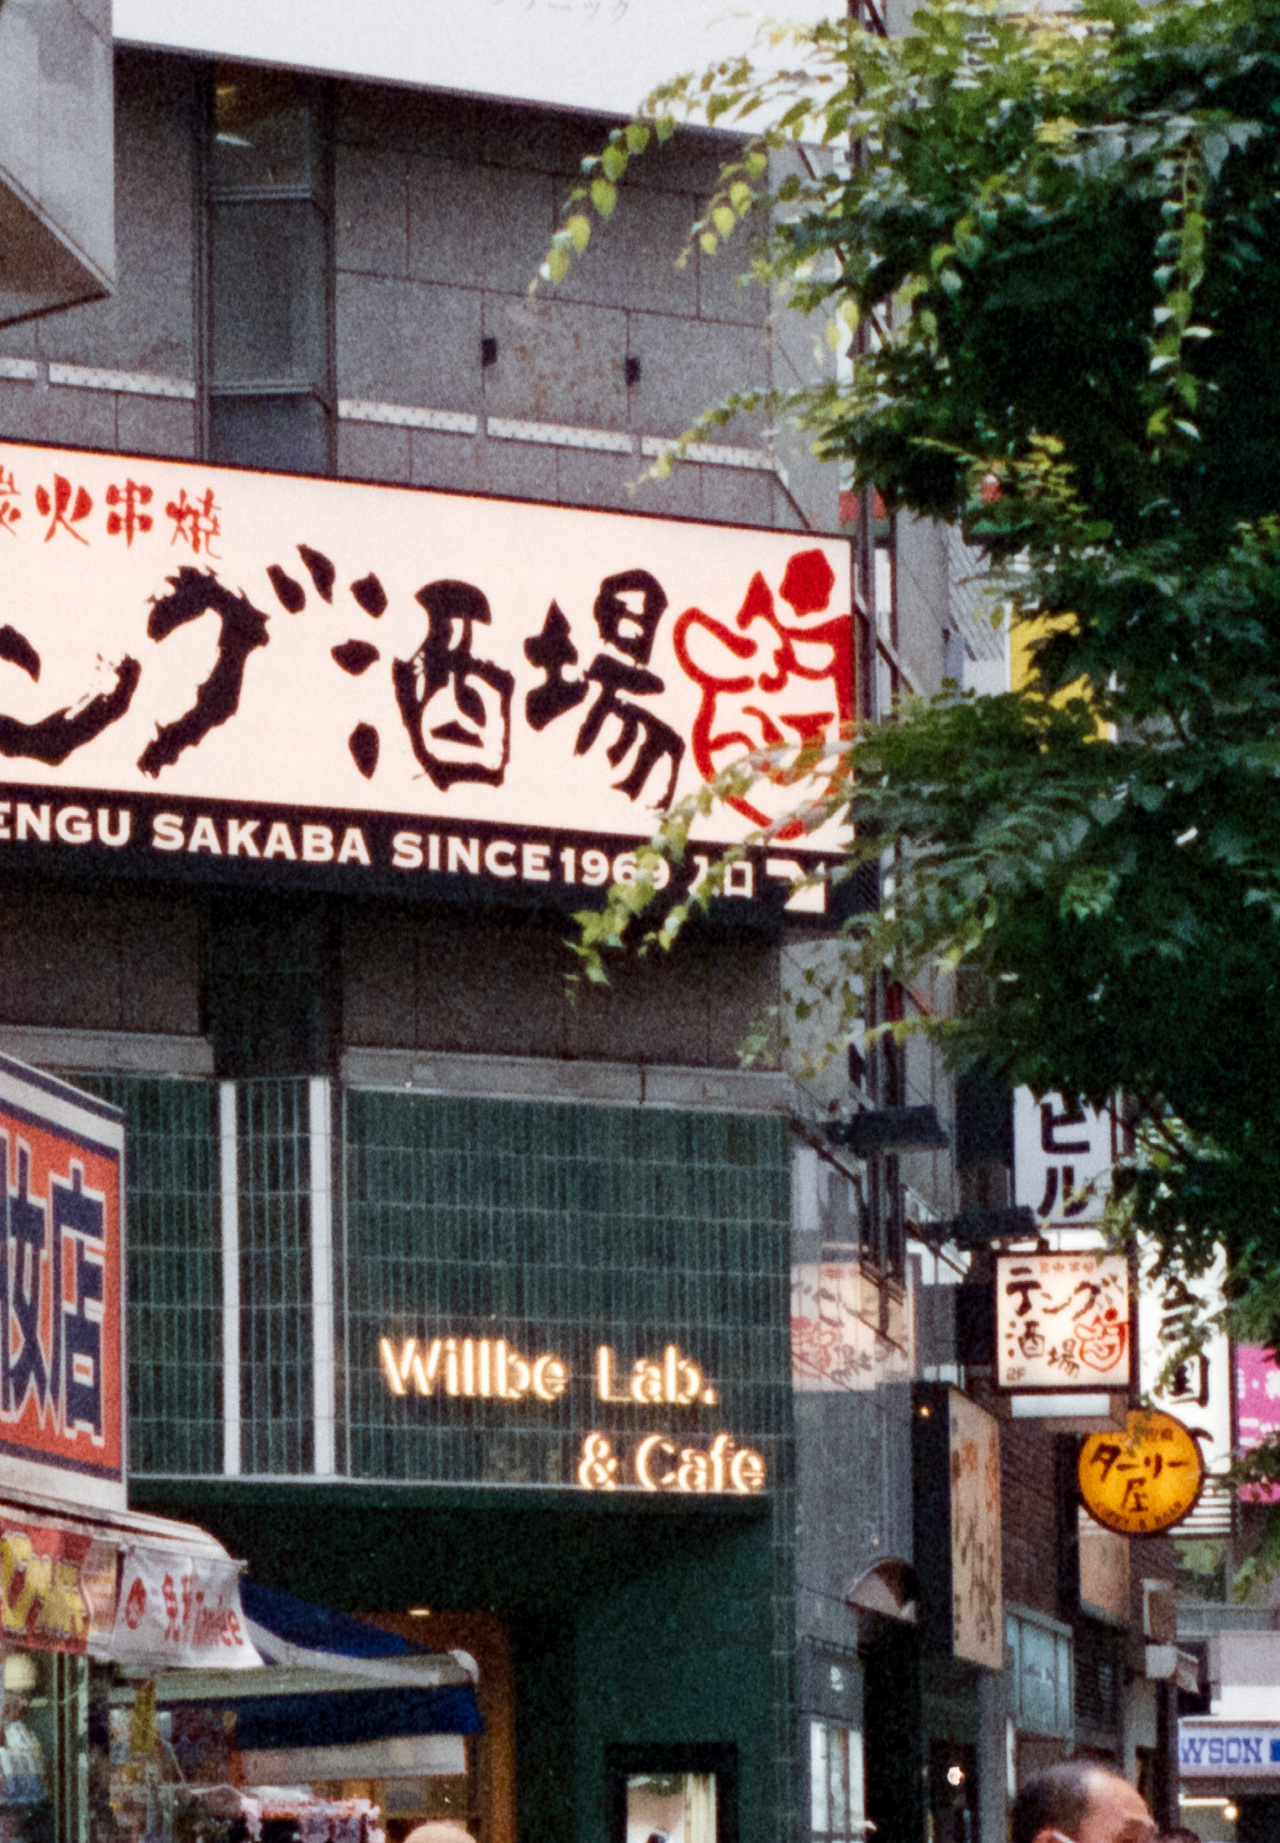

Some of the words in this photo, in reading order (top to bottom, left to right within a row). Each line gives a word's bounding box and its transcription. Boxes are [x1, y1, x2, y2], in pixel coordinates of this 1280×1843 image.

[151, 813, 371, 868] SAKABA
[1005, 1265, 1126, 1322] テング
[379, 1336, 568, 1400] Willbe
[576, 1431, 619, 1493] &
[634, 1432, 768, 1496] Cafe
